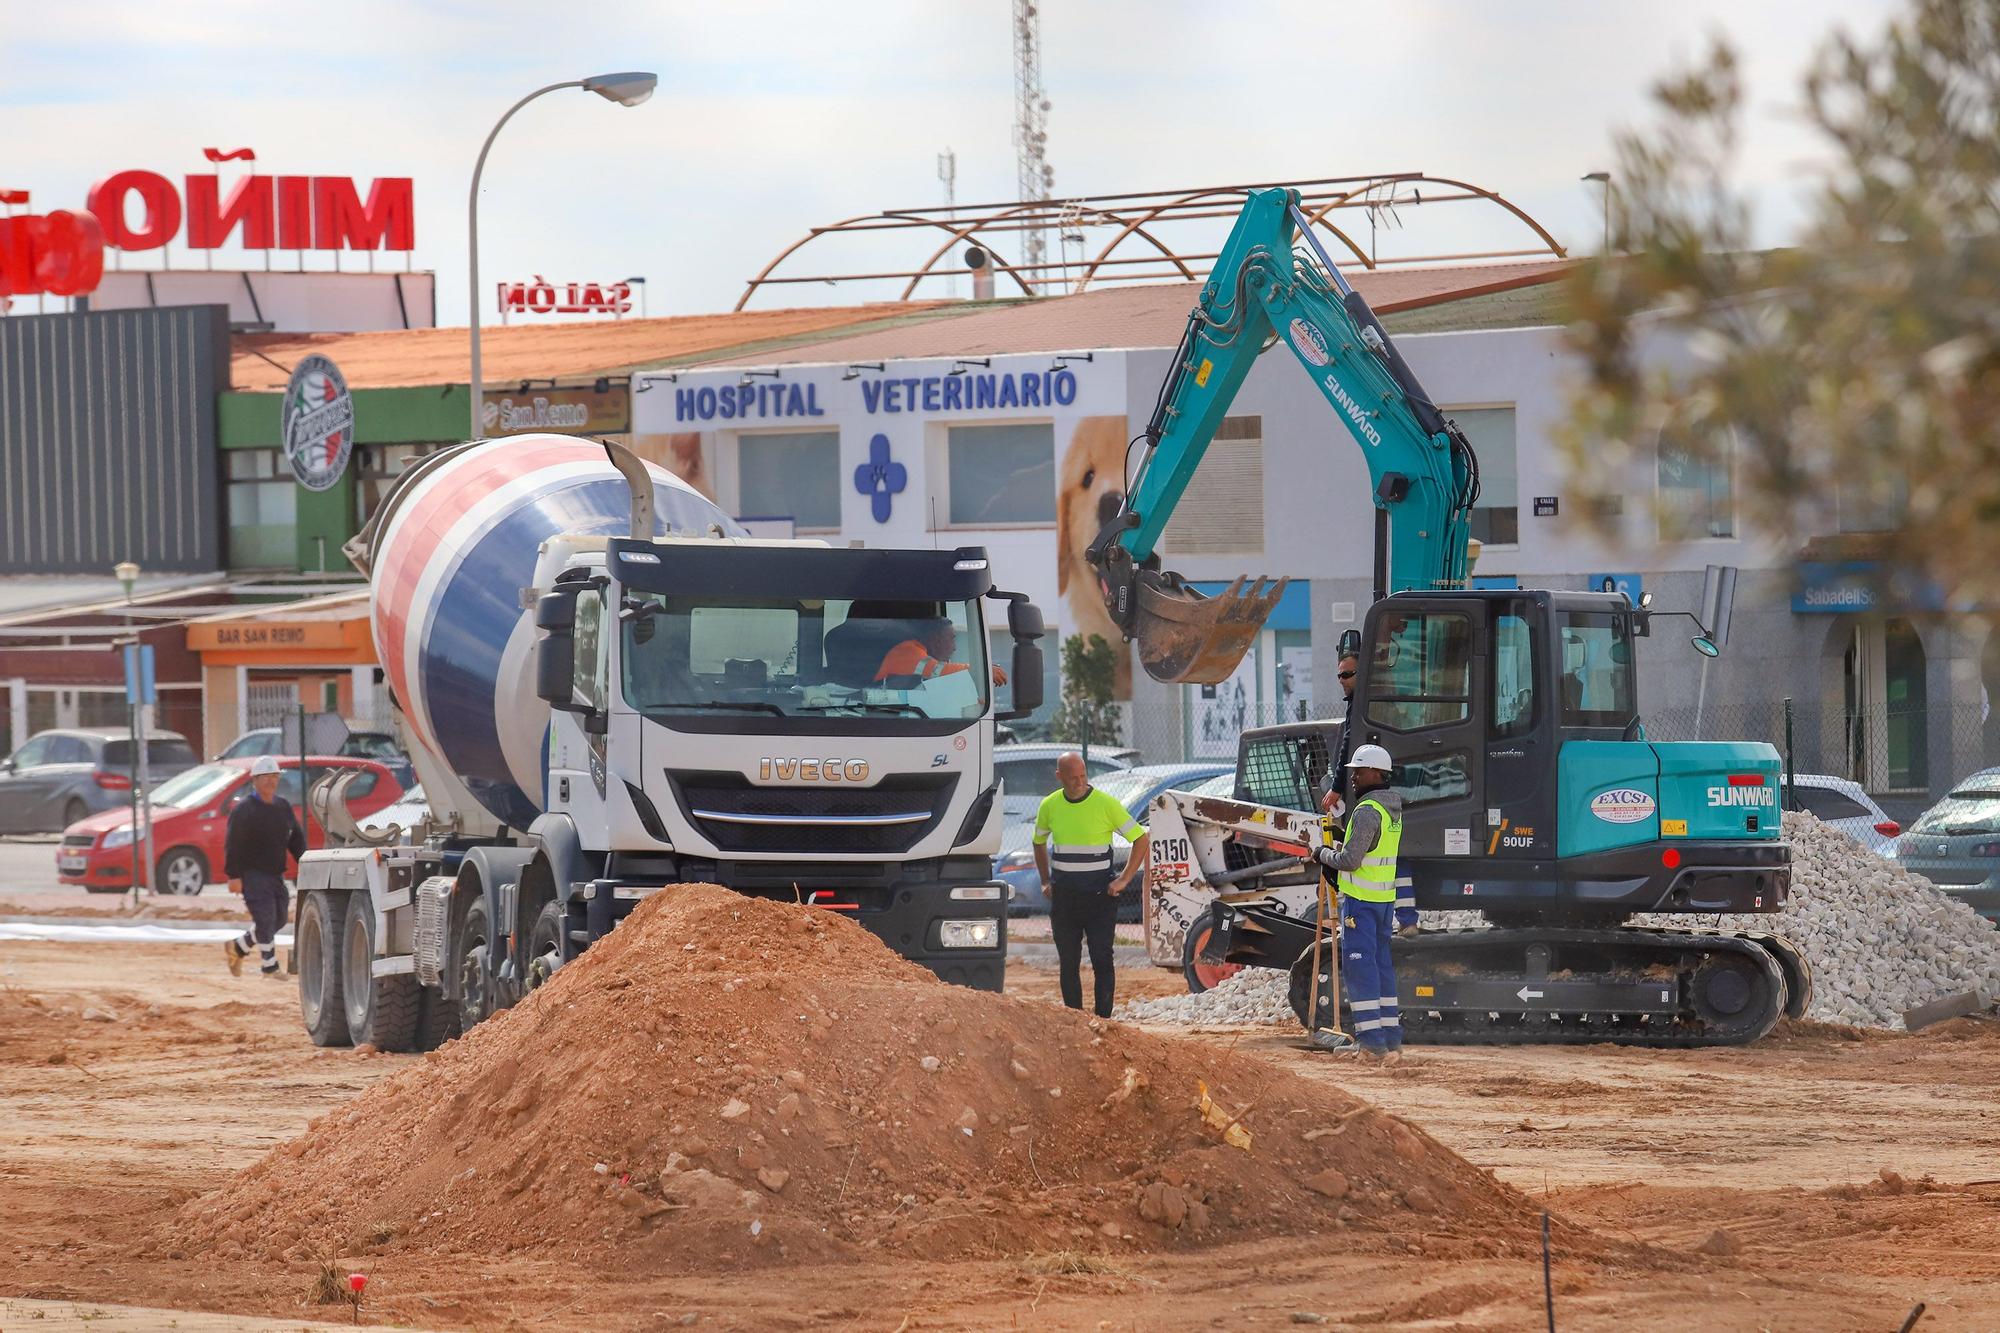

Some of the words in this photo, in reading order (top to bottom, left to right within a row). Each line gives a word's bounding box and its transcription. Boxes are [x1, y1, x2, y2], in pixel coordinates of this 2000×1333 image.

[676, 382, 824, 421] HOSPITAL
[861, 371, 1076, 414] VETERINARIO
[1324, 374, 1381, 447] SUNWARD
[217, 628, 240, 644] BAR
[243, 628, 267, 643] SAN
[271, 627, 305, 643] REMO
[759, 757, 870, 782] IVECO
[1598, 790, 1648, 804] EXCSI
[1707, 786, 1773, 807] SUNWARD
[1514, 827, 1534, 835] SWE
[1151, 838, 1189, 863] S150
[1503, 836, 1534, 848] 90UF
